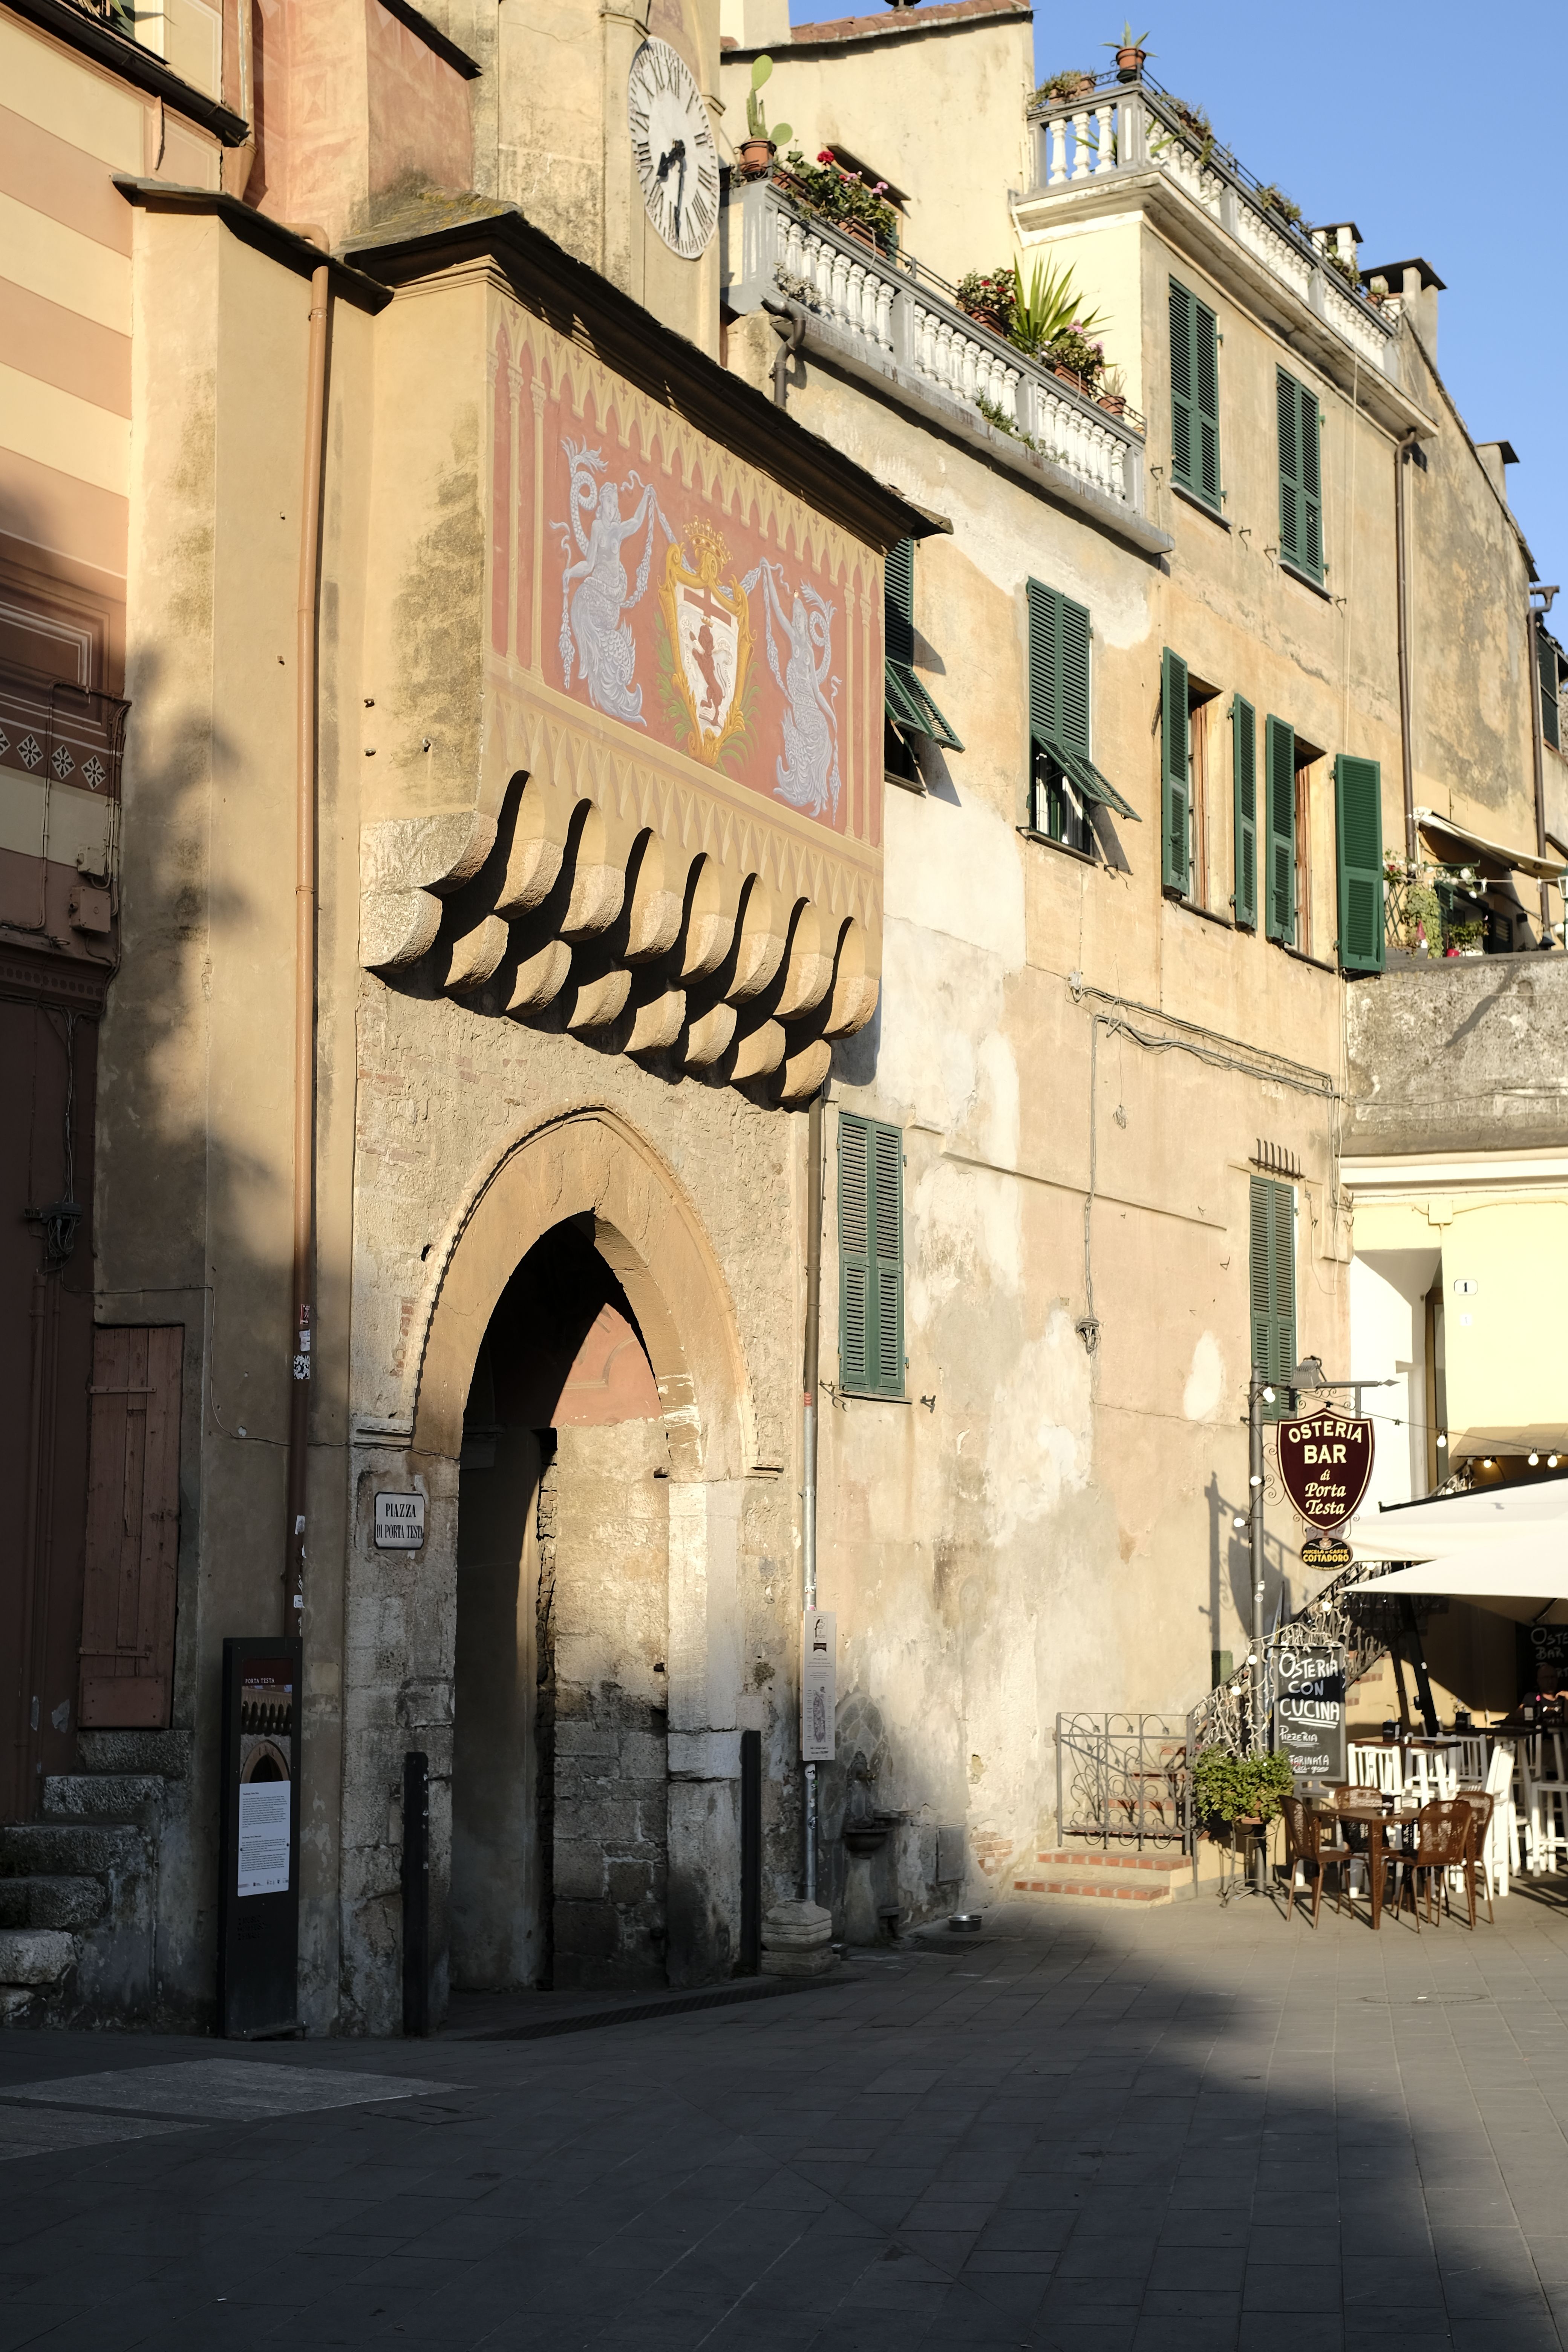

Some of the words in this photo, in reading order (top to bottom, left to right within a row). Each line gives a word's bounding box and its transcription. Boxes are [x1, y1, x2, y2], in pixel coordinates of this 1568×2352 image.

[1464, 1282, 1468, 1292] 1
[1288, 1421, 1362, 1443] OSTERIA
[1304, 1444, 1347, 1464] BAR
[1320, 1469, 1331, 1481] di
[1305, 1482, 1347, 1497] Porta
[386, 1503, 416, 1517] PIAZZA
[1306, 1499, 1346, 1515] Testa
[377, 1524, 382, 1538] DI
[385, 1524, 404, 1538] PORTA
[407, 1525, 423, 1539] TESTA
[1536, 1647, 1564, 1660] BAR
[1279, 1653, 1338, 1679] OSTERIA
[1288, 1680, 1324, 1696] CON
[1280, 1698, 1340, 1721] CUCINA
[1279, 1725, 1318, 1742] PIZZERIA
